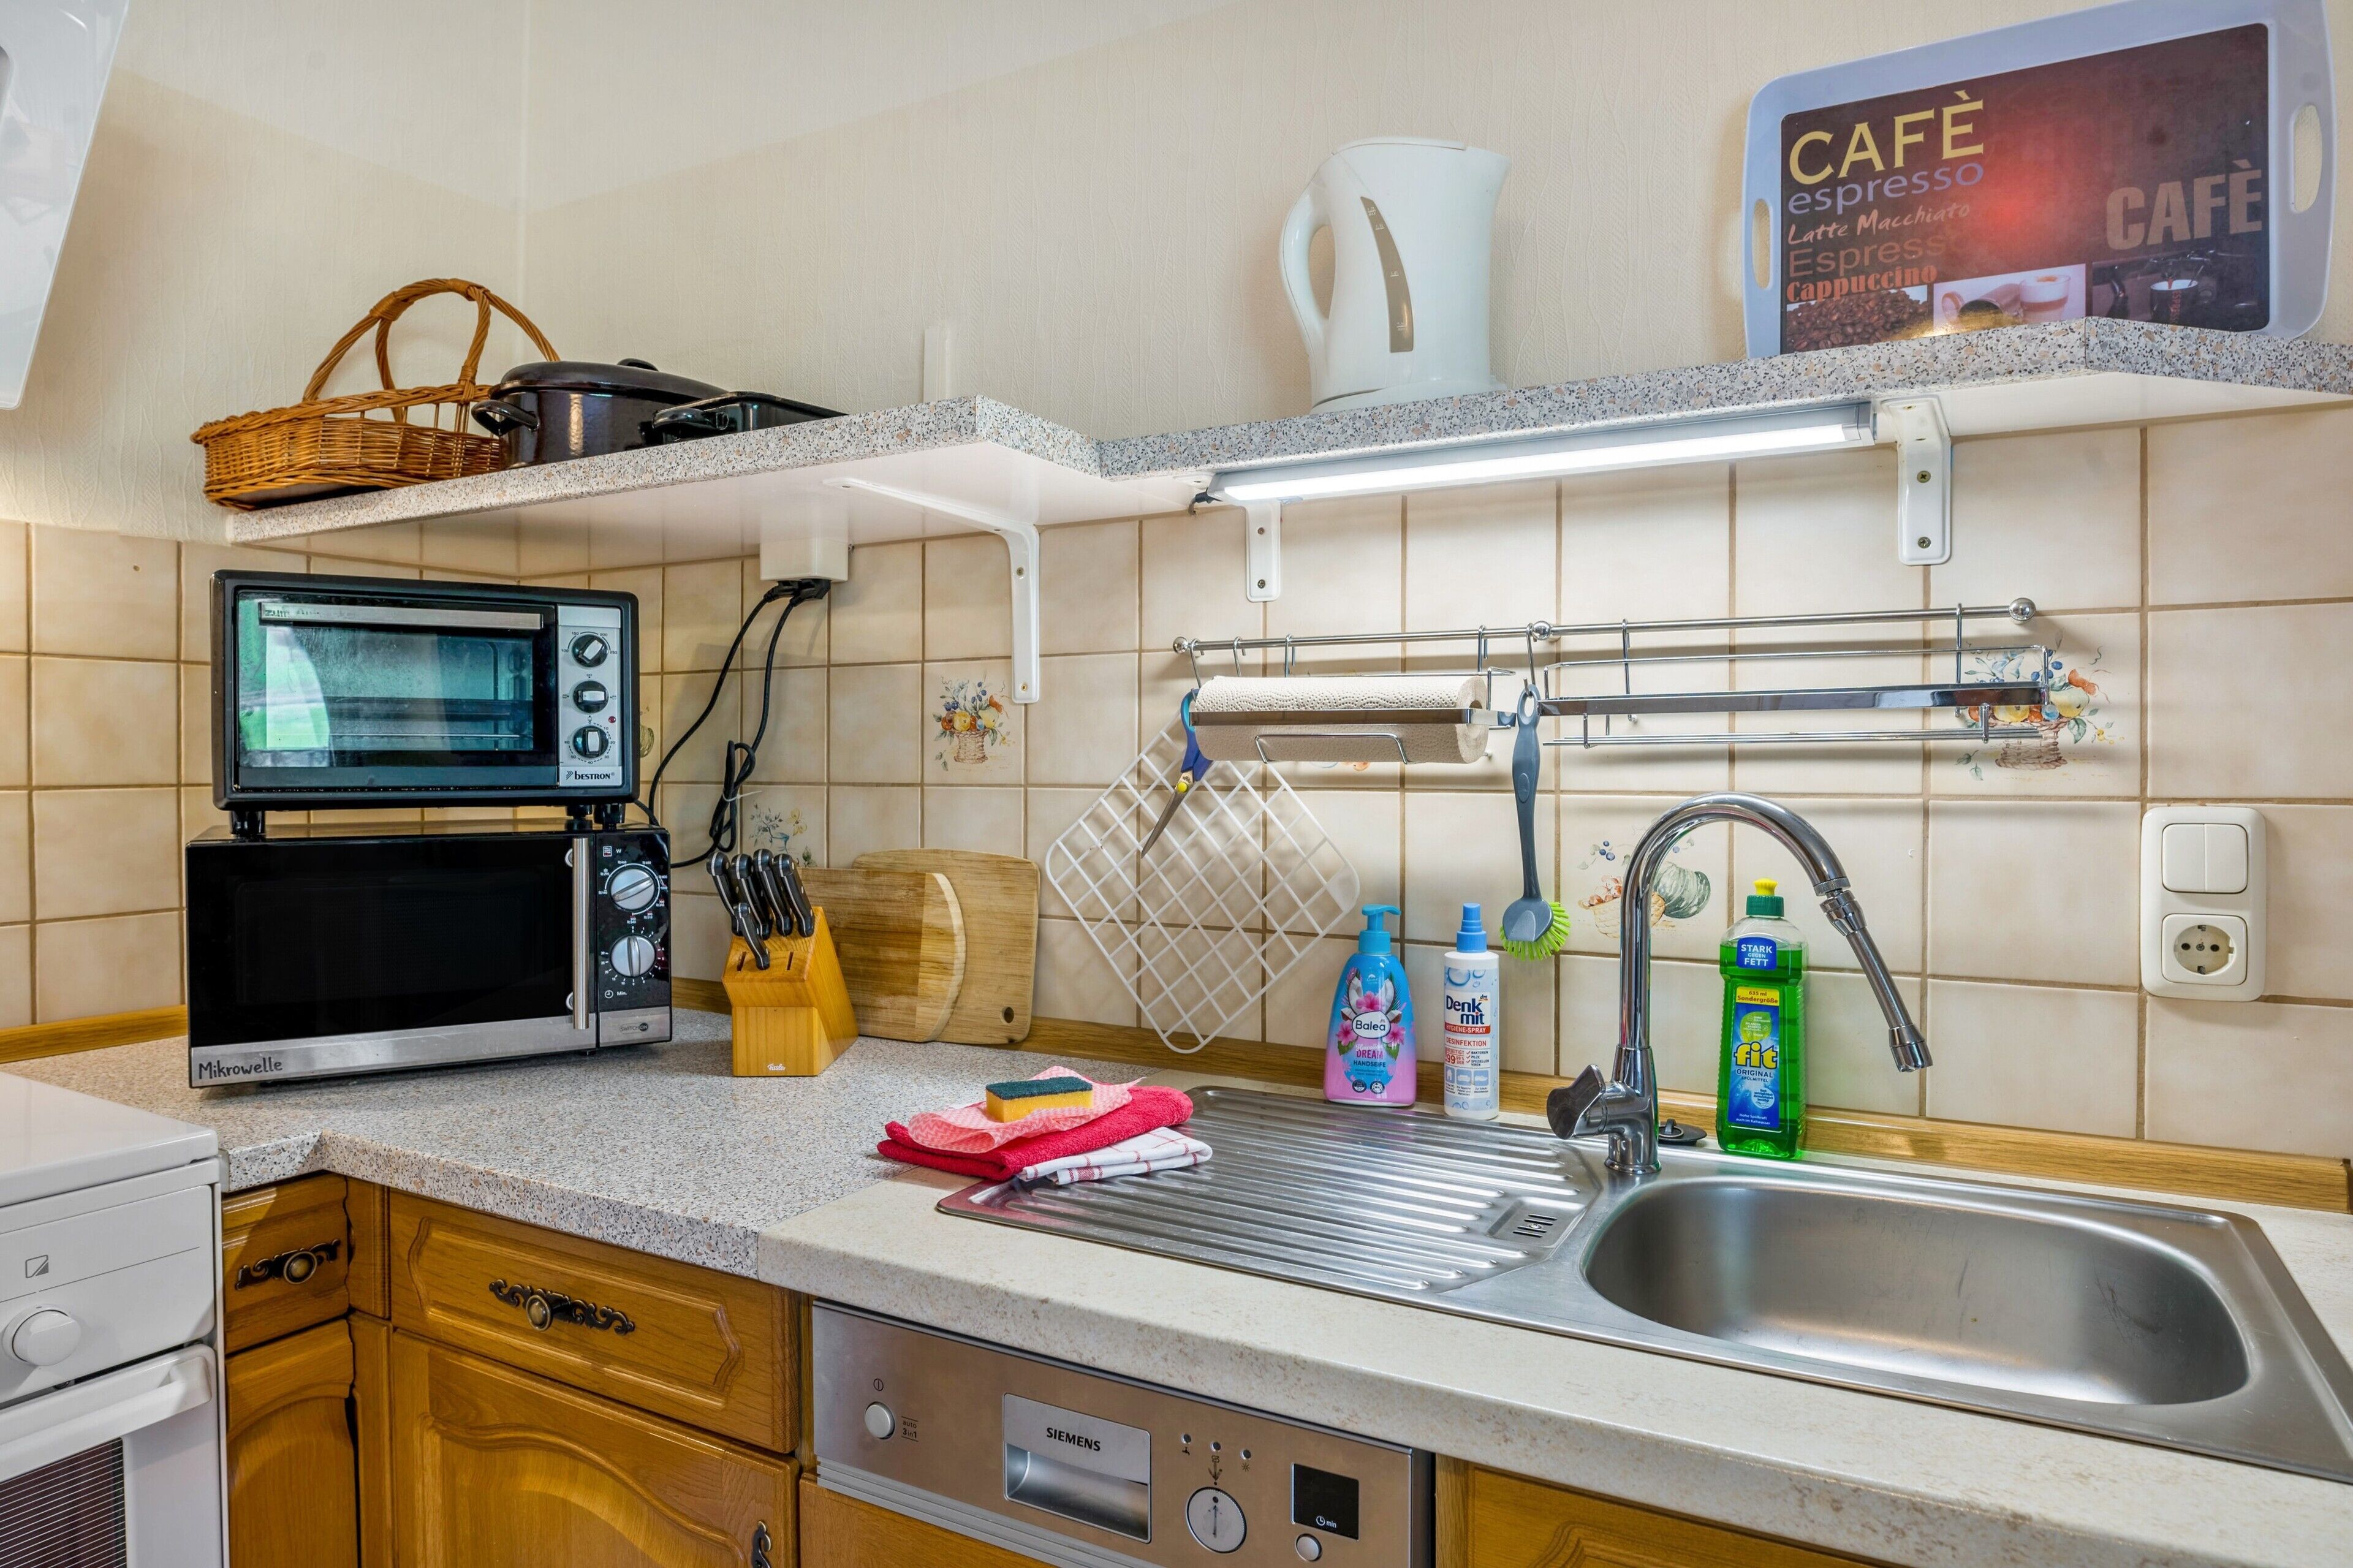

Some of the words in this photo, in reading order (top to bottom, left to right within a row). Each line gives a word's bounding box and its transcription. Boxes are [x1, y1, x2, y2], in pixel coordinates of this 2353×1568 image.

[1789, 90, 1984, 185] CAFÈ
[1788, 162, 1984, 215] espresso
[2107, 159, 2262, 251] CAFÈ
[1787, 224, 1848, 244] Latte
[1857, 203, 1970, 235] Macchiato
[1787, 264, 1938, 303] Cappuccino
[1741, 944, 1773, 953] STARK
[1744, 958, 1769, 966] FETT
[1446, 995, 1482, 1013] Denk
[1737, 995, 1778, 1004] Sondergröße
[1355, 1020, 1386, 1031] Balea
[1460, 1012, 1484, 1025] mit
[1446, 1037, 1487, 1047] DESINFEKTION
[1356, 1050, 1383, 1059] DREAM
[1733, 1041, 1778, 1069] fit
[199, 1056, 283, 1080] Mikrowelle
[1737, 1069, 1773, 1078] ORIGINAL
[903, 1420, 917, 1429] auto
[1046, 1426, 1101, 1452] SIEMENS
